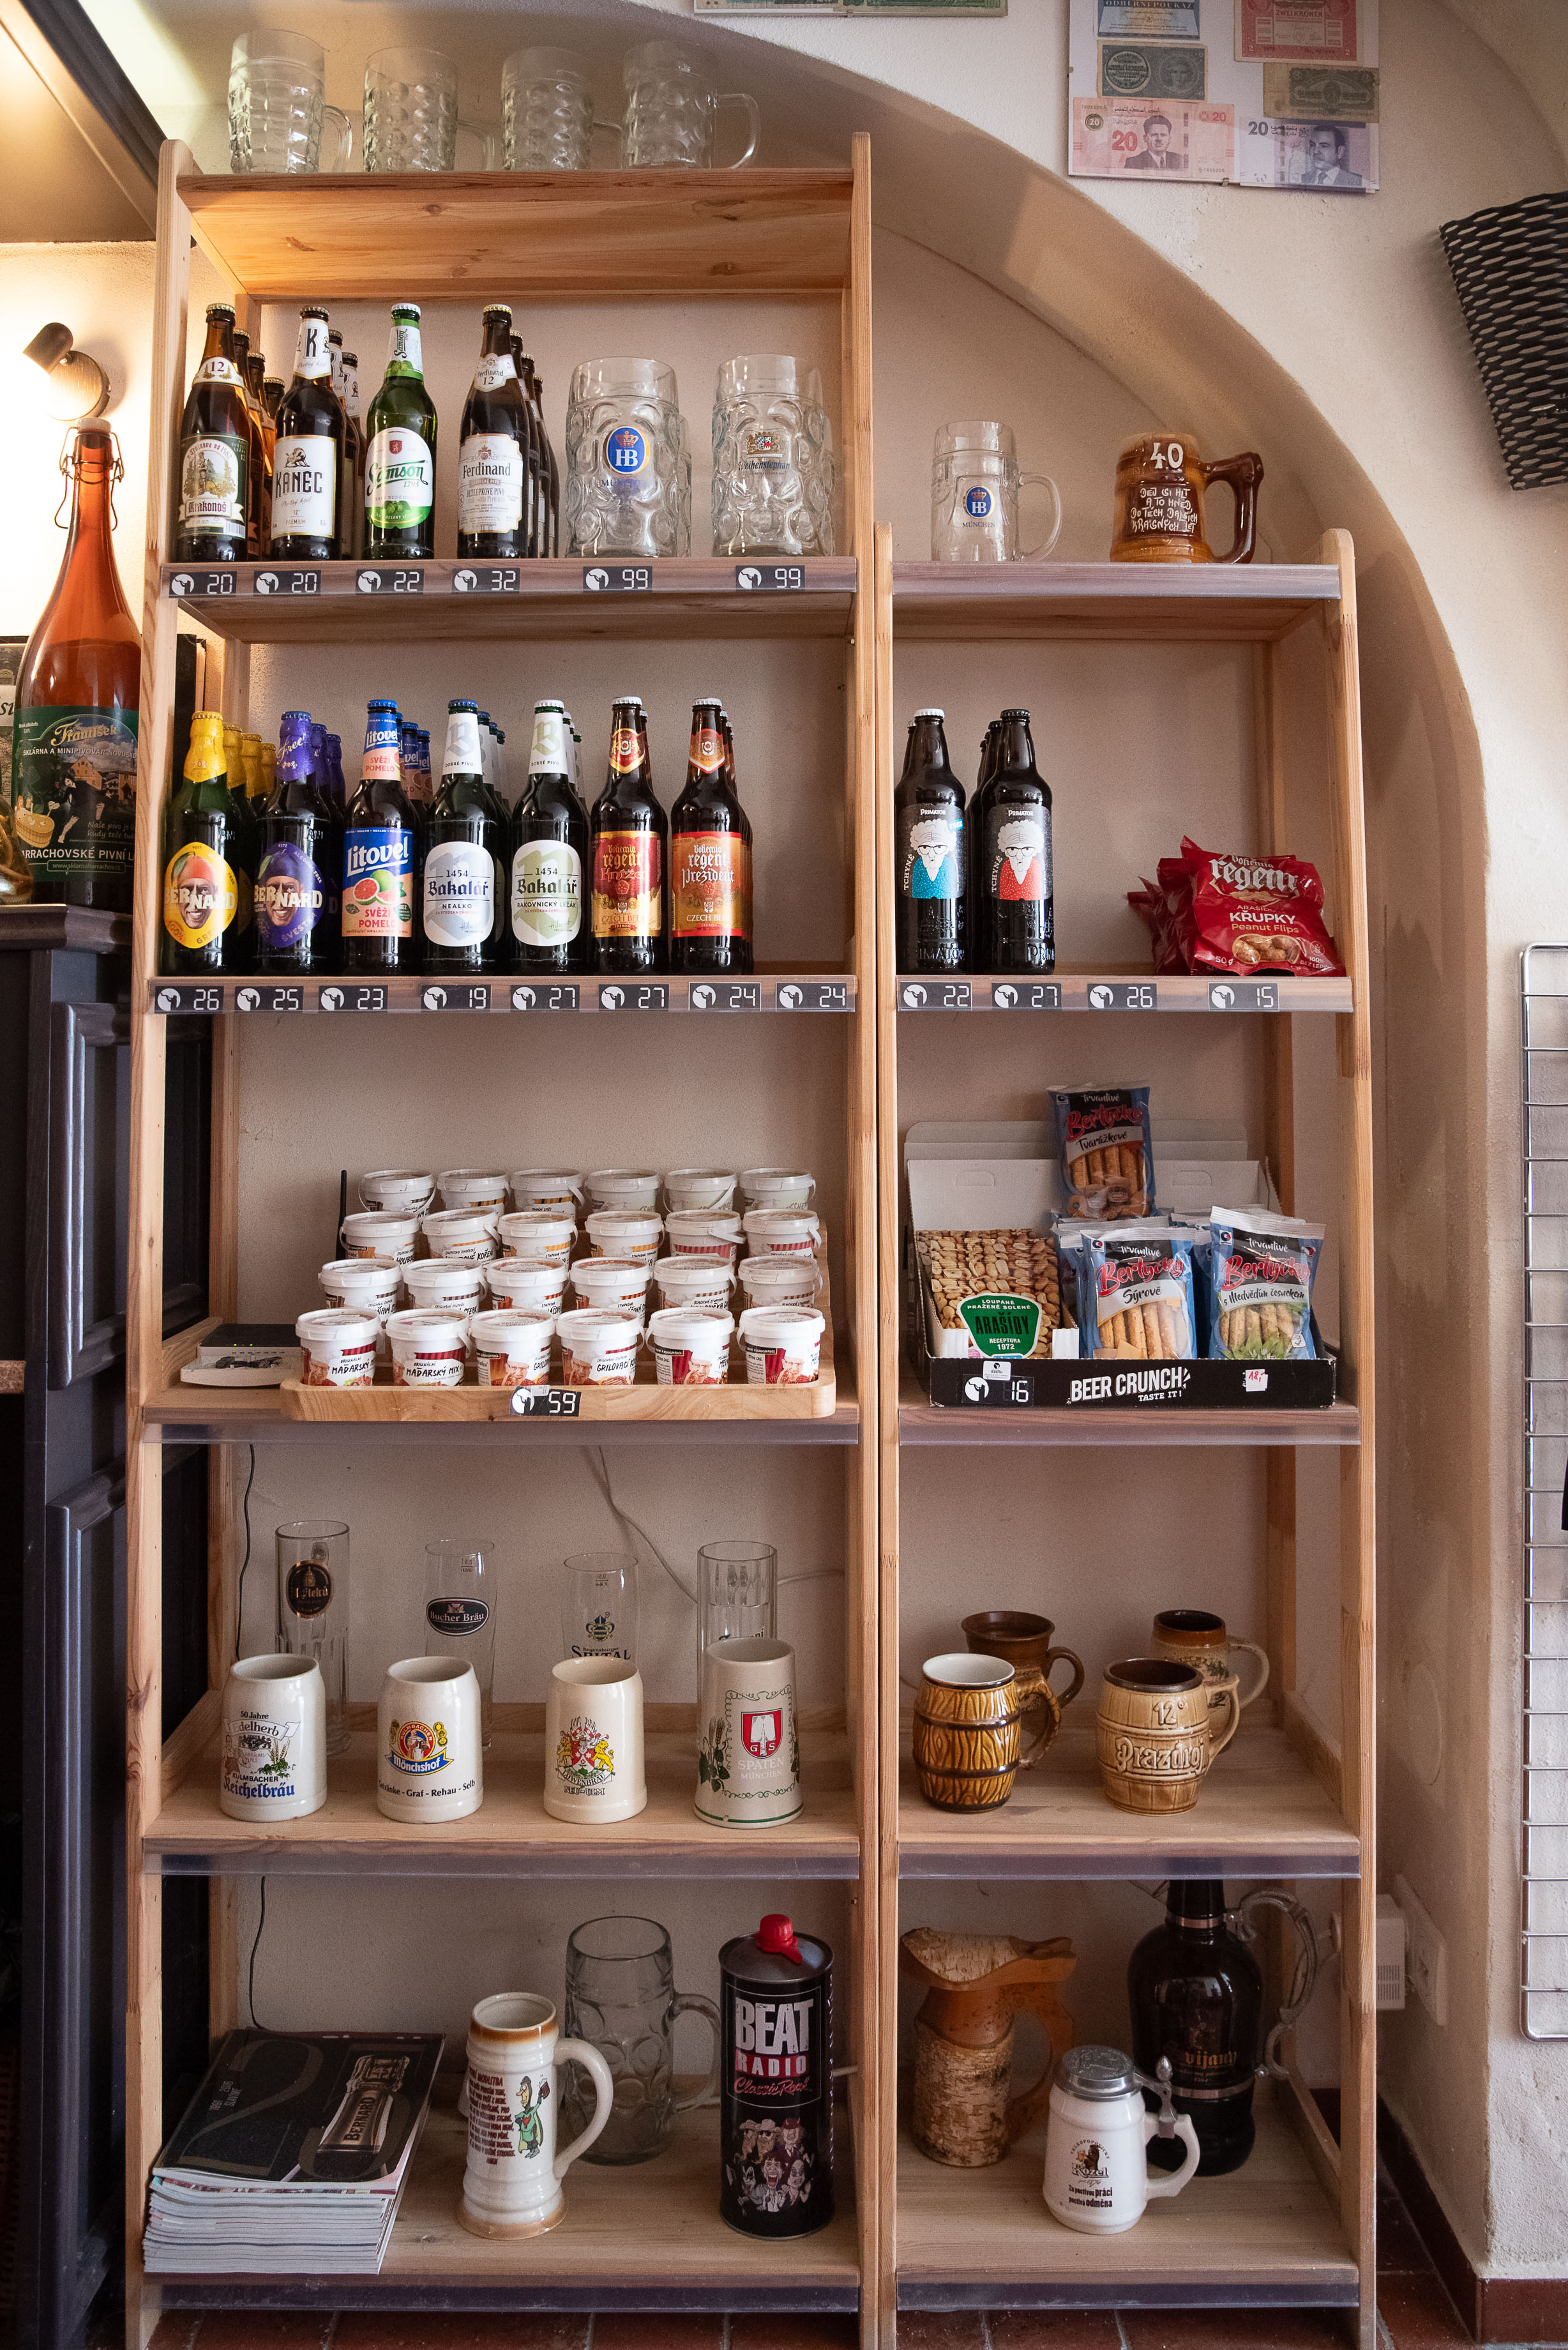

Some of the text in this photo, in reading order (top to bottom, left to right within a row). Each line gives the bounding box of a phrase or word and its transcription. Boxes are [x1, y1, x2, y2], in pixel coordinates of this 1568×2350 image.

[1089, 118, 1100, 126] 20
[1212, 111, 1227, 122] 20
[1248, 121, 1269, 136] 20
[1112, 130, 1138, 152] 20
[305, 328, 318, 358] K
[393, 328, 407, 359] Samson
[210, 361, 225, 372] 12
[477, 369, 504, 379] Ferdinand
[482, 377, 494, 386] 12
[615, 449, 638, 467] HB
[1150, 442, 1185, 470] 40
[463, 462, 511, 480] Ferdinand
[737, 460, 790, 472] Weihenstephan
[275, 470, 323, 499] KANEC
[366, 461, 429, 497] Samson
[494, 487, 506, 496] PIVO
[188, 501, 227, 513] Krakonoš
[971, 501, 987, 515] HB
[1146, 496, 1165, 508] A TO
[1130, 507, 1142, 520] DO
[961, 520, 996, 528] MÜNCHEN
[207, 573, 232, 595] 20
[291, 572, 317, 593] 20
[393, 571, 420, 592] 22
[491, 570, 516, 591] 32
[622, 569, 649, 589] 99
[774, 568, 801, 589] 99
[51, 717, 117, 747] František
[366, 725, 398, 748] Litovel
[23, 747, 49, 756] SKLÁRNA
[948, 821, 963, 830] FREE
[98, 847, 126, 860] PIVNÍ
[347, 835, 410, 878] Litovel
[693, 844, 722, 854] Bohemia
[603, 851, 642, 869] regent
[688, 851, 727, 870] regent
[313, 870, 322, 884] FREE
[446, 869, 469, 878] 1454
[535, 867, 559, 876] 1454
[682, 867, 734, 889] Prezident
[903, 853, 916, 891] TCHYNĚ
[991, 854, 1003, 893] TCHYNĚ
[1209, 856, 1299, 891] regent
[428, 880, 488, 897] Bakalář
[516, 879, 578, 894] Bakalář
[253, 884, 323, 909] BERNARD
[516, 900, 577, 908] RAKOVNICKÝ LEŽÁK
[365, 906, 391, 918] SVĚŽÍ
[601, 914, 625, 923] CZECH
[686, 914, 711, 923] CZECH
[1229, 910, 1297, 925] KŘUPKY
[1231, 923, 1300, 934] Peanut Flips
[1215, 956, 1227, 965] 50
[193, 989, 220, 1011] 26
[273, 989, 299, 1010] 25
[357, 989, 384, 1010] 23
[469, 987, 487, 1009] 19
[549, 987, 576, 1010] 27
[638, 987, 665, 1009] 27
[729, 986, 757, 1008] 24
[819, 986, 846, 1008] 24
[944, 985, 970, 1008] 22
[1031, 986, 1059, 1008] 27
[1127, 986, 1154, 1008] 26
[1256, 986, 1275, 1008] 15
[1082, 1093, 1120, 1103] trvanlivé
[1119, 1244, 1162, 1257] trvanlivé
[1246, 1236, 1289, 1253] trvanlivé
[1097, 1255, 1184, 1298] Bertyčky
[1220, 1252, 1311, 1291] Bertyčky
[1122, 1286, 1162, 1305] Sýrové
[974, 1312, 1030, 1335] ARAŠÍDY
[331, 1360, 370, 1375] MAĎARSKÝ
[406, 1365, 460, 1377] MAĎARSKÝ MIX
[597, 1358, 629, 1372] GRILOVACÍ
[1011, 1379, 1030, 1403] 16
[1071, 1365, 1182, 1403] BEER CRUNCH
[548, 1391, 577, 1414] 59
[1138, 1392, 1165, 1402] TASTE
[430, 1611, 485, 1622] Bucher Bräu
[248, 1711, 269, 1720] Jahre
[398, 1723, 434, 1741] KULMBACHER
[750, 1742, 776, 1753] G S
[1115, 1736, 1206, 1775] Prazdroj
[393, 1754, 441, 1773] Mönchshof
[737, 1755, 785, 1771] SPATEN
[232, 1772, 279, 1783] KULMBACHER
[740, 1769, 783, 1780] MÜNCHEN
[223, 1775, 296, 1799] Reichelbräu
[405, 1779, 476, 1798] Graf Rehau Selb
[735, 1996, 815, 2056] BEAT
[736, 2054, 808, 2077] RADIO
[733, 2076, 812, 2096] Classic Rock
[343, 2095, 376, 2142] BERNARD
[1071, 2162, 1109, 2179] Kozel
[1095, 2187, 1113, 2198] práci
[1085, 2197, 1113, 2208] odměna
